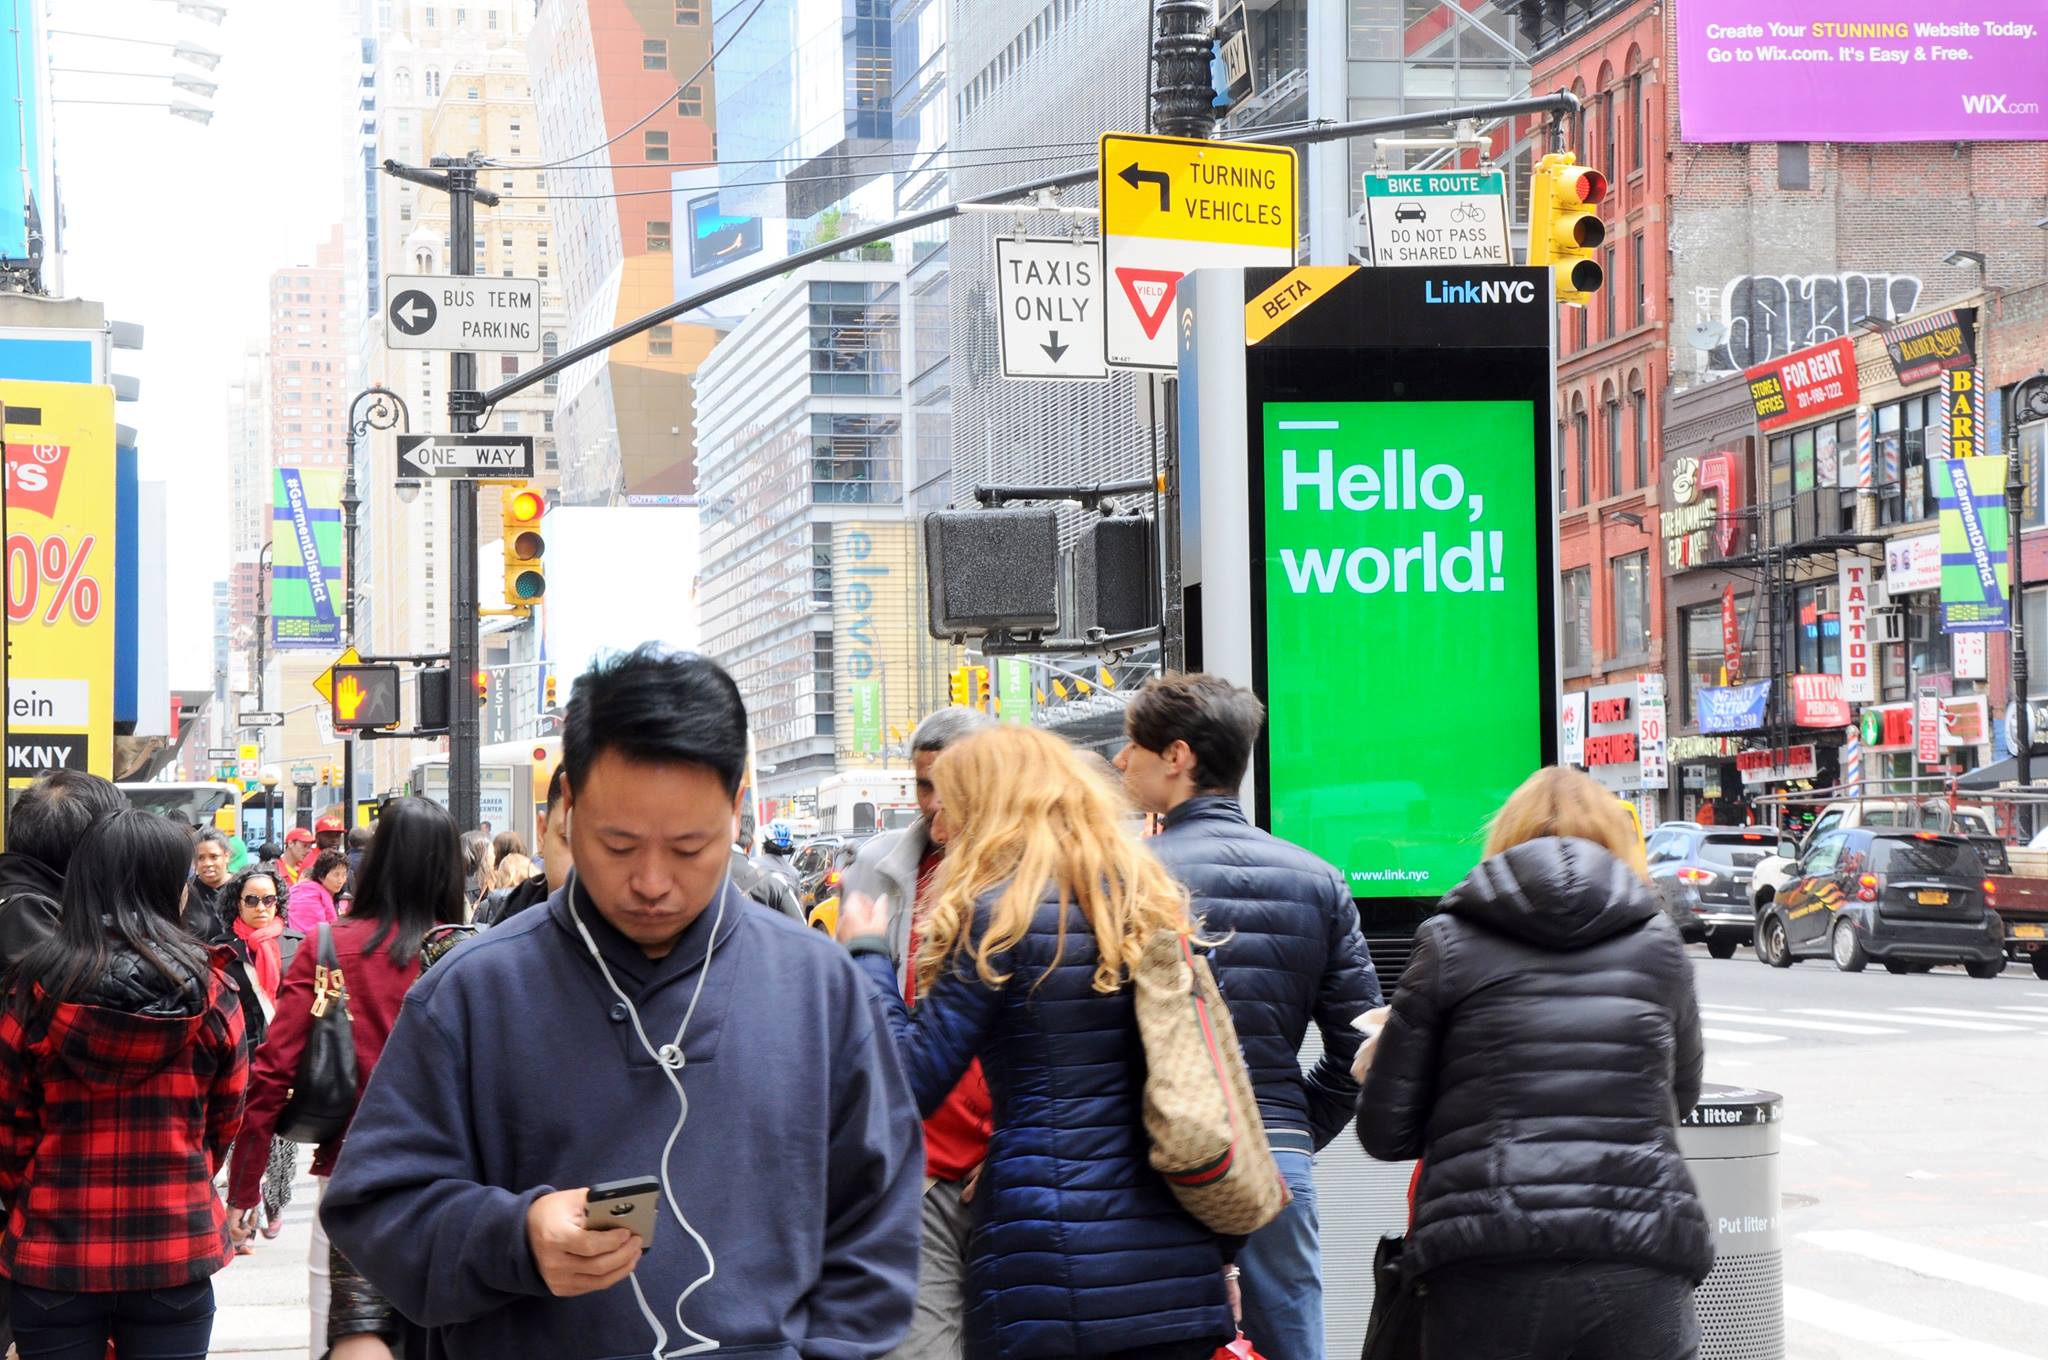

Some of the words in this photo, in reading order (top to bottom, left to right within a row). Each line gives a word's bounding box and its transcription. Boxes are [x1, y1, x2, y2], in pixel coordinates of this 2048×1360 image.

[1706, 24, 1763, 39] Create
[1768, 22, 1806, 37] Your
[1812, 22, 1909, 38] STUNNING
[1914, 22, 1980, 37] Website
[1983, 21, 2037, 39] Today.
[1707, 47, 1732, 62] Go
[1736, 48, 1753, 61] to
[1756, 45, 1834, 61] Wix.com.
[1839, 46, 1865, 61] It's
[1869, 47, 1910, 64] Easy
[1914, 46, 1927, 61] &
[1931, 46, 1974, 60] Free.
[1190, 163, 1275, 189] TURNING
[1387, 178, 1423, 192] BIKE
[1429, 177, 1480, 192] ROUTE
[1185, 197, 1281, 225] VEHICLES
[1391, 230, 1410, 243] DO
[1417, 229, 1443, 242] NOT
[1450, 228, 1487, 241] PASS
[1380, 248, 1392, 260] IN
[1400, 247, 1457, 260] SHARED
[1464, 245, 1501, 259] LANE
[1009, 259, 1091, 286] TAXIS
[443, 290, 475, 307] BUS
[488, 291, 531, 308] TERM
[1137, 286, 1163, 296] YIELD
[1261, 279, 1312, 319] BETA
[1426, 280, 1535, 304] LinkNYC
[1015, 296, 1089, 322] ONLY
[462, 321, 530, 339] PARKING
[1781, 361, 1811, 391] FOR
[1807, 349, 1843, 383] RENT
[1751, 379, 1773, 399] STORE
[1755, 394, 1785, 416] OFFICES
[418, 448, 456, 464] ONE
[476, 448, 516, 465] WAY
[1282, 449, 1483, 523] Hello,
[1951, 467, 1995, 587] #GarmentDistrict
[286, 478, 327, 603] #GarmentDistrict
[1279, 531, 1505, 593] world!
[1848, 567, 1866, 677] TATTOO
[491, 669, 505, 742] WESTIN
[1592, 697, 1628, 724] FANCY
[1641, 720, 1659, 740] 50
[1584, 732, 1637, 768] PERFUMES
[1351, 869, 1429, 882] www.link.nyc
[1704, 1108, 1742, 1123] litter
[1719, 1218, 1741, 1233] Put
[1744, 1216, 1768, 1232] litter
